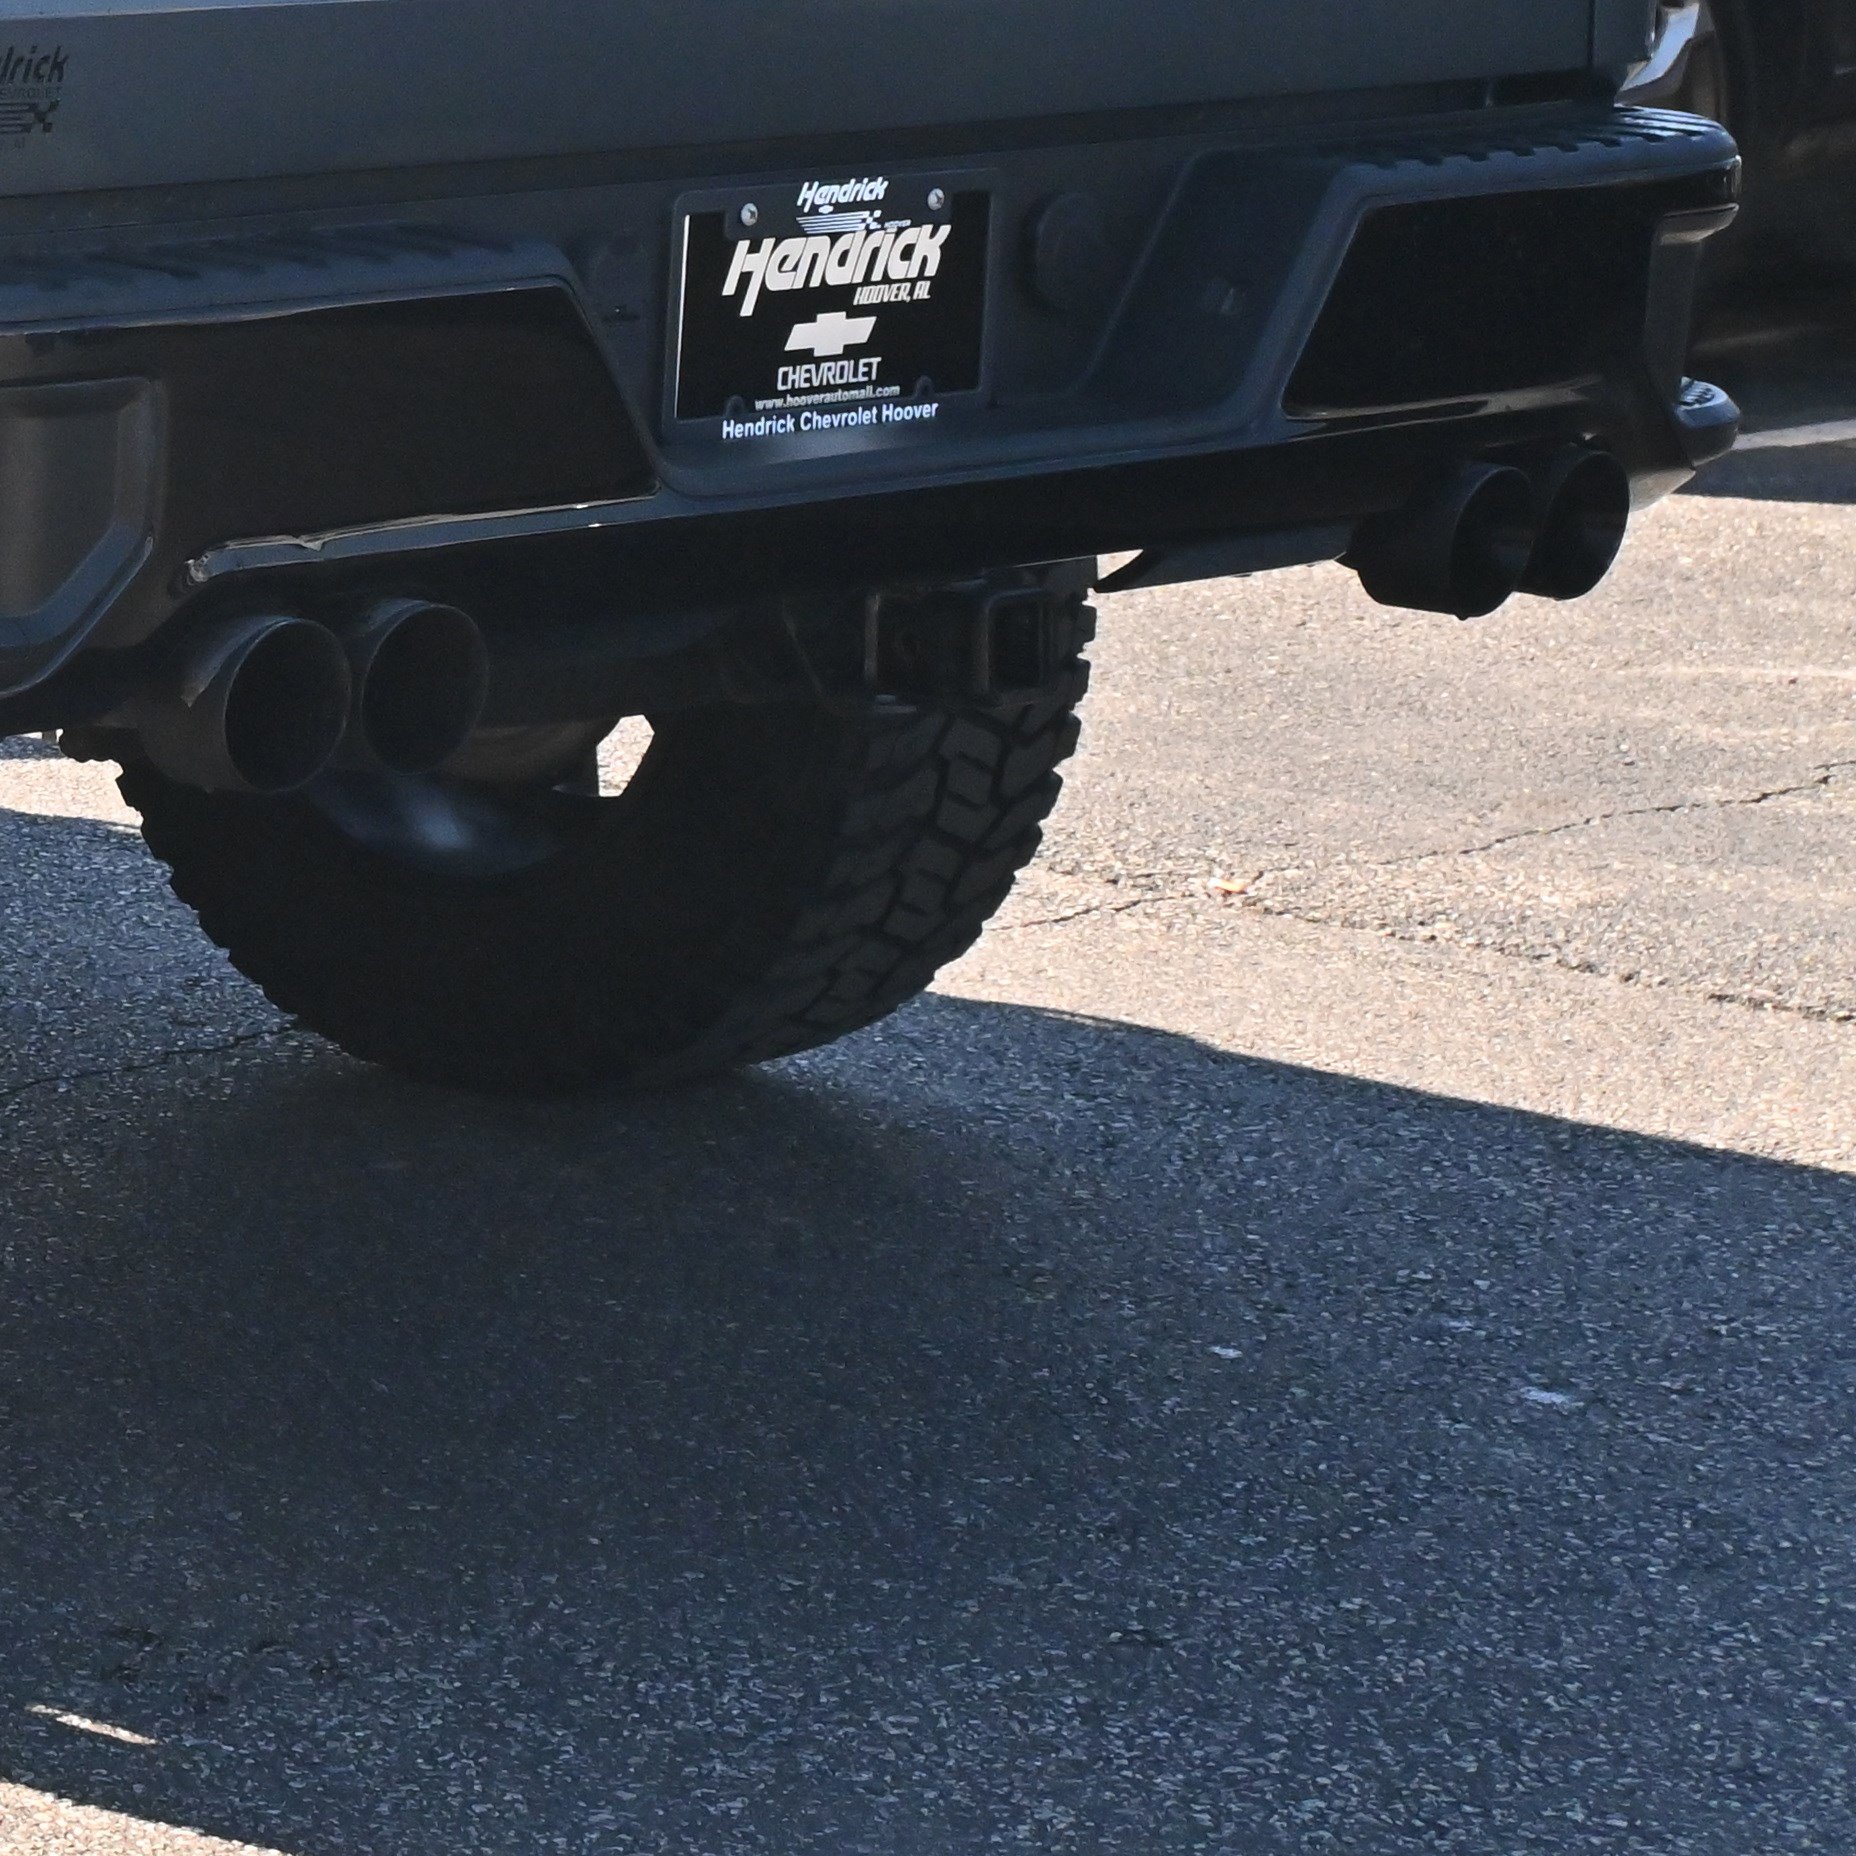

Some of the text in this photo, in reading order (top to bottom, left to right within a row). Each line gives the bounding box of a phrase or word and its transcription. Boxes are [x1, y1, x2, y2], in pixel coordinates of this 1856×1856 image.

[796, 176, 889, 213] Hendrick
[722, 224, 952, 317] Hendrick
[912, 280, 931, 301] AL
[777, 357, 882, 391] CHEVROLET
[722, 402, 939, 440] Hendrick Chevrolet Hoover
